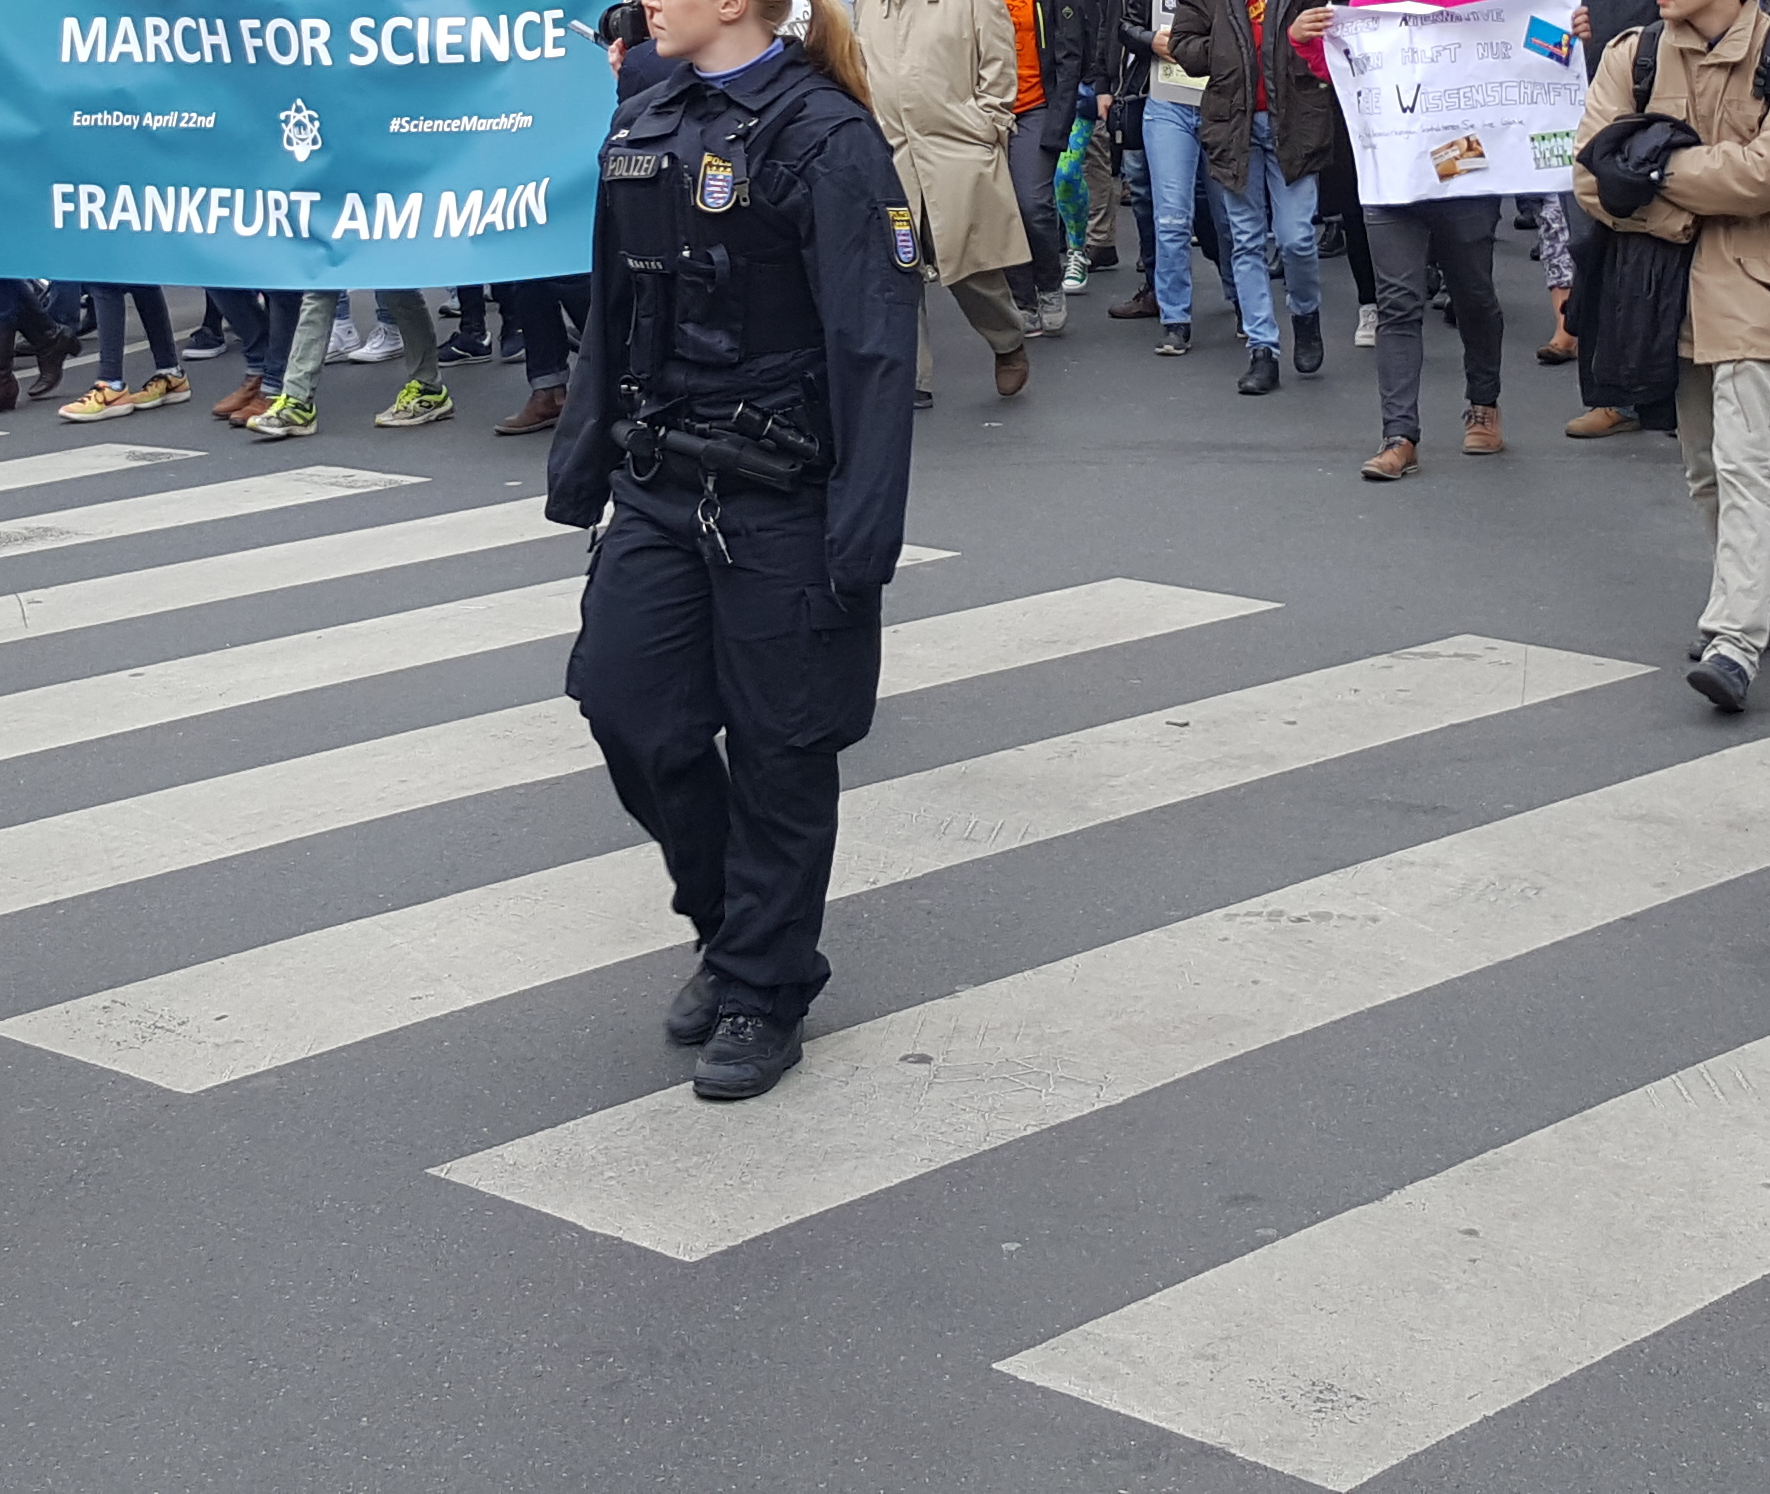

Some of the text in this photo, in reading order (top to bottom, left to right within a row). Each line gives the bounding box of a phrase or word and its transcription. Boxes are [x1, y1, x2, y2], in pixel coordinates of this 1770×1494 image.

[60, 9, 567, 66] MARCH FOR SCIENCE
[1476, 41, 1512, 60] NUR
[72, 110, 533, 135] EarthDay April 22nd #ScienceMarchFfm
[606, 155, 657, 177] POLIZEI
[53, 177, 548, 240] FRANKFURT AM MAIN
